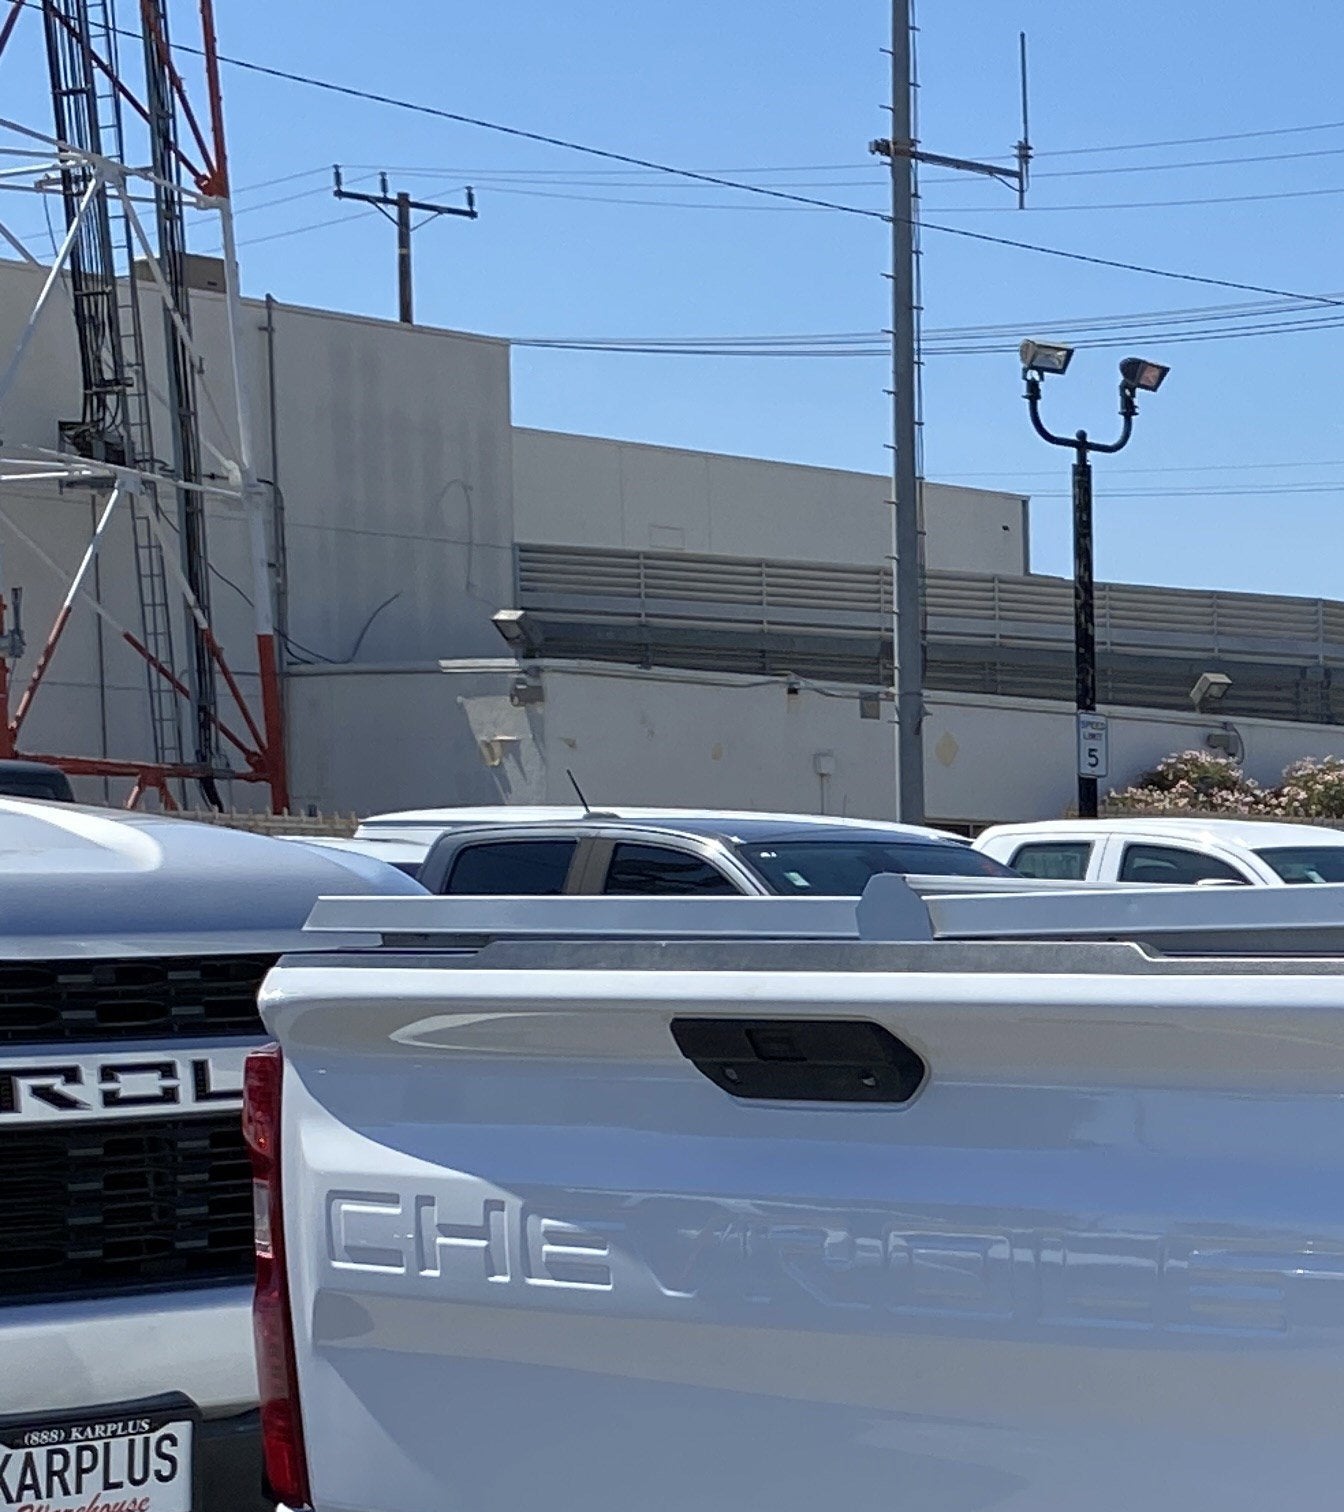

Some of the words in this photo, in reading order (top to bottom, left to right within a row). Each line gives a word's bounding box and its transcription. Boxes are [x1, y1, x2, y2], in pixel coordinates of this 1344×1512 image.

[1088, 747, 1099, 768] 5
[24, 1428, 65, 1446] (888)
[70, 1418, 151, 1442] KARPLUS
[0, 1432, 179, 1505] KARPLUS
